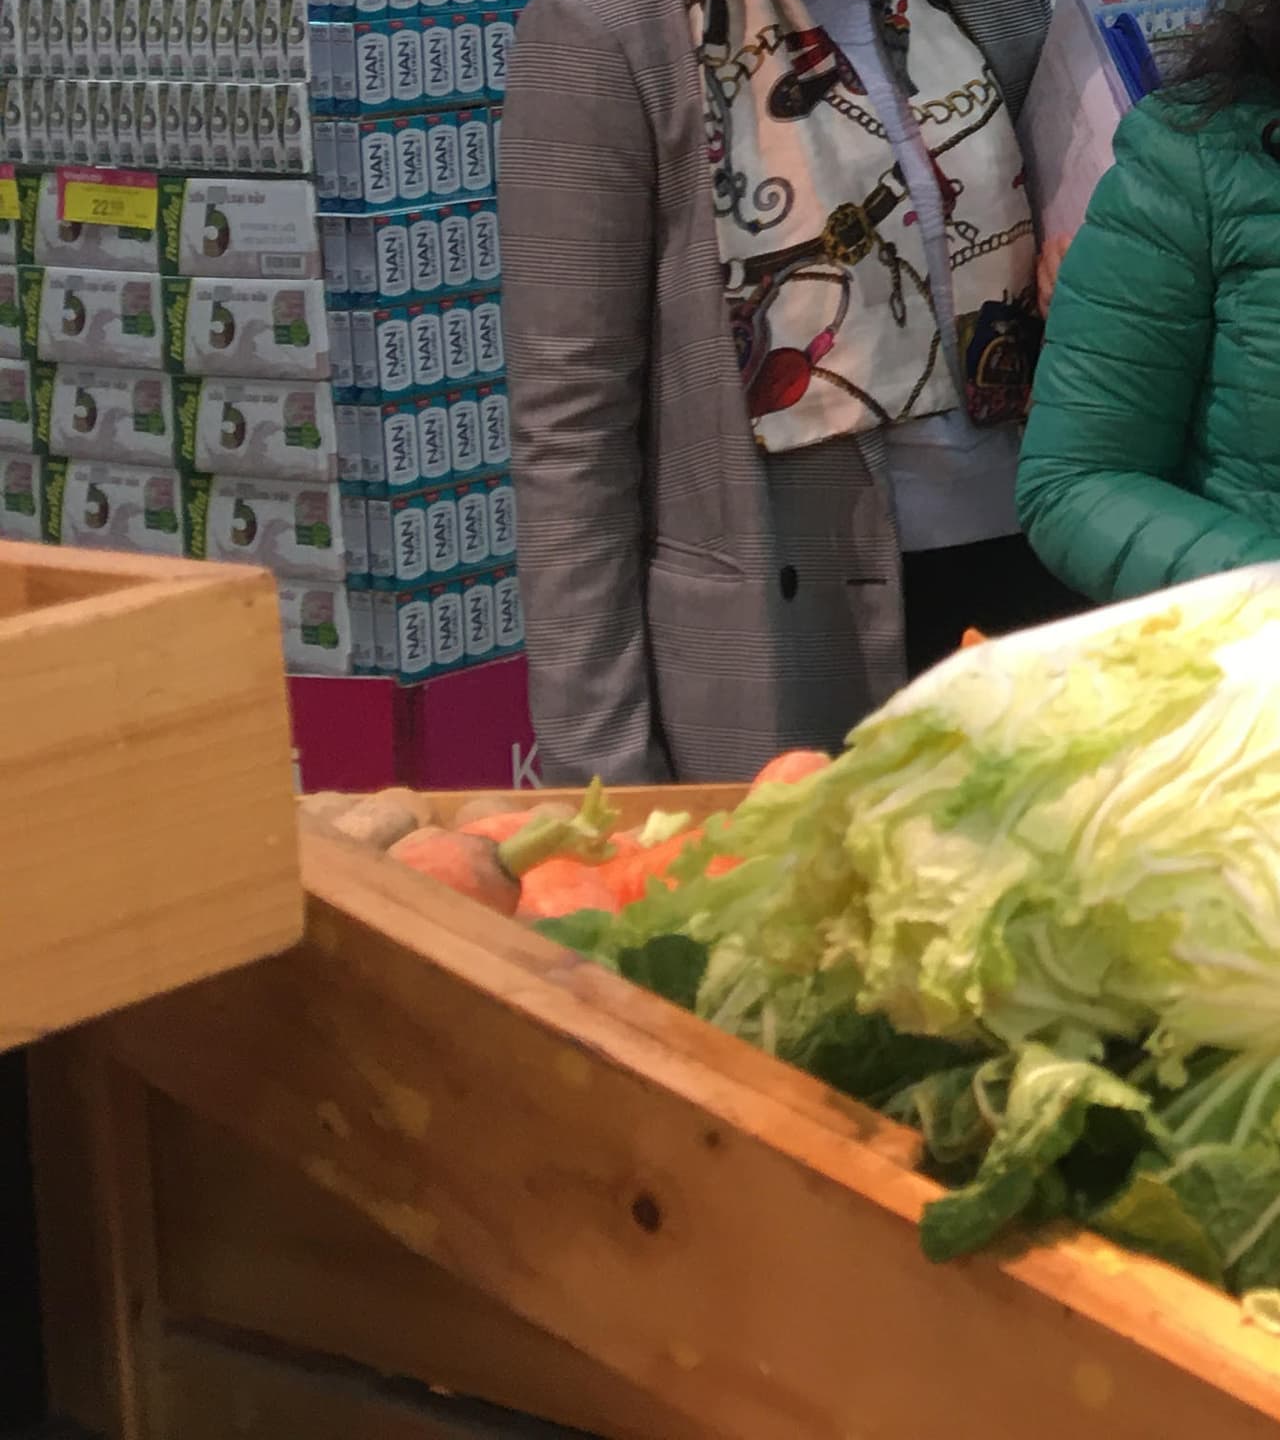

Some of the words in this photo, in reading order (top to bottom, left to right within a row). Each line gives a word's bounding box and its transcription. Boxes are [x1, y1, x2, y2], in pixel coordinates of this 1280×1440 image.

[366, 44, 378, 91] NAN
[400, 41, 412, 86] NAN
[371, 143, 384, 190] NAN
[407, 612, 421, 661] NAN
